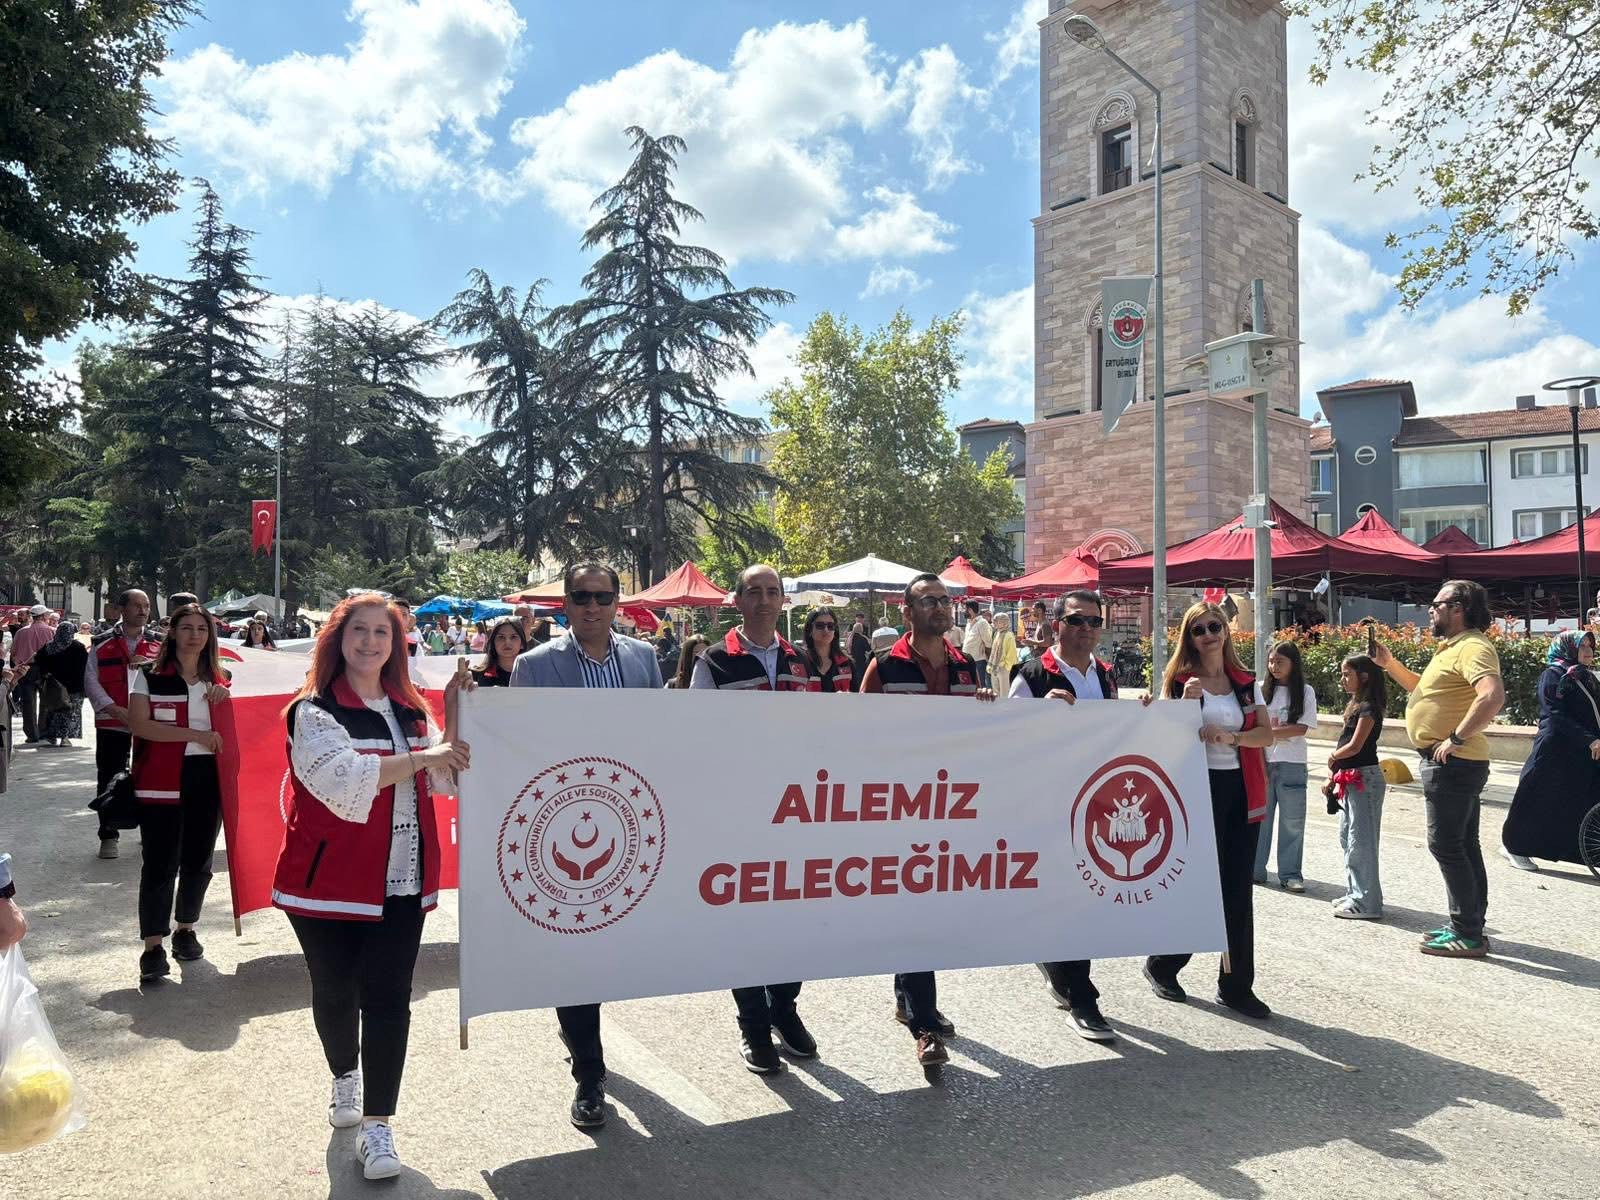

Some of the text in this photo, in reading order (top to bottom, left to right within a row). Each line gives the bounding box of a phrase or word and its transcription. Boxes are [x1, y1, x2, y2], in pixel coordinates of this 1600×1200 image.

[553, 792, 574, 809] AİLE
[574, 788, 587, 798] VE
[588, 787, 621, 806] SOSYAL
[771, 768, 980, 824] AİLEMİZ
[529, 804, 554, 872] CUMHURİYETİ
[592, 856, 633, 899] BAKANLIĞI
[699, 838, 1039, 907] GELECEĞİMİZ
[1075, 857, 1187, 905] 2025 AİLE YILI
